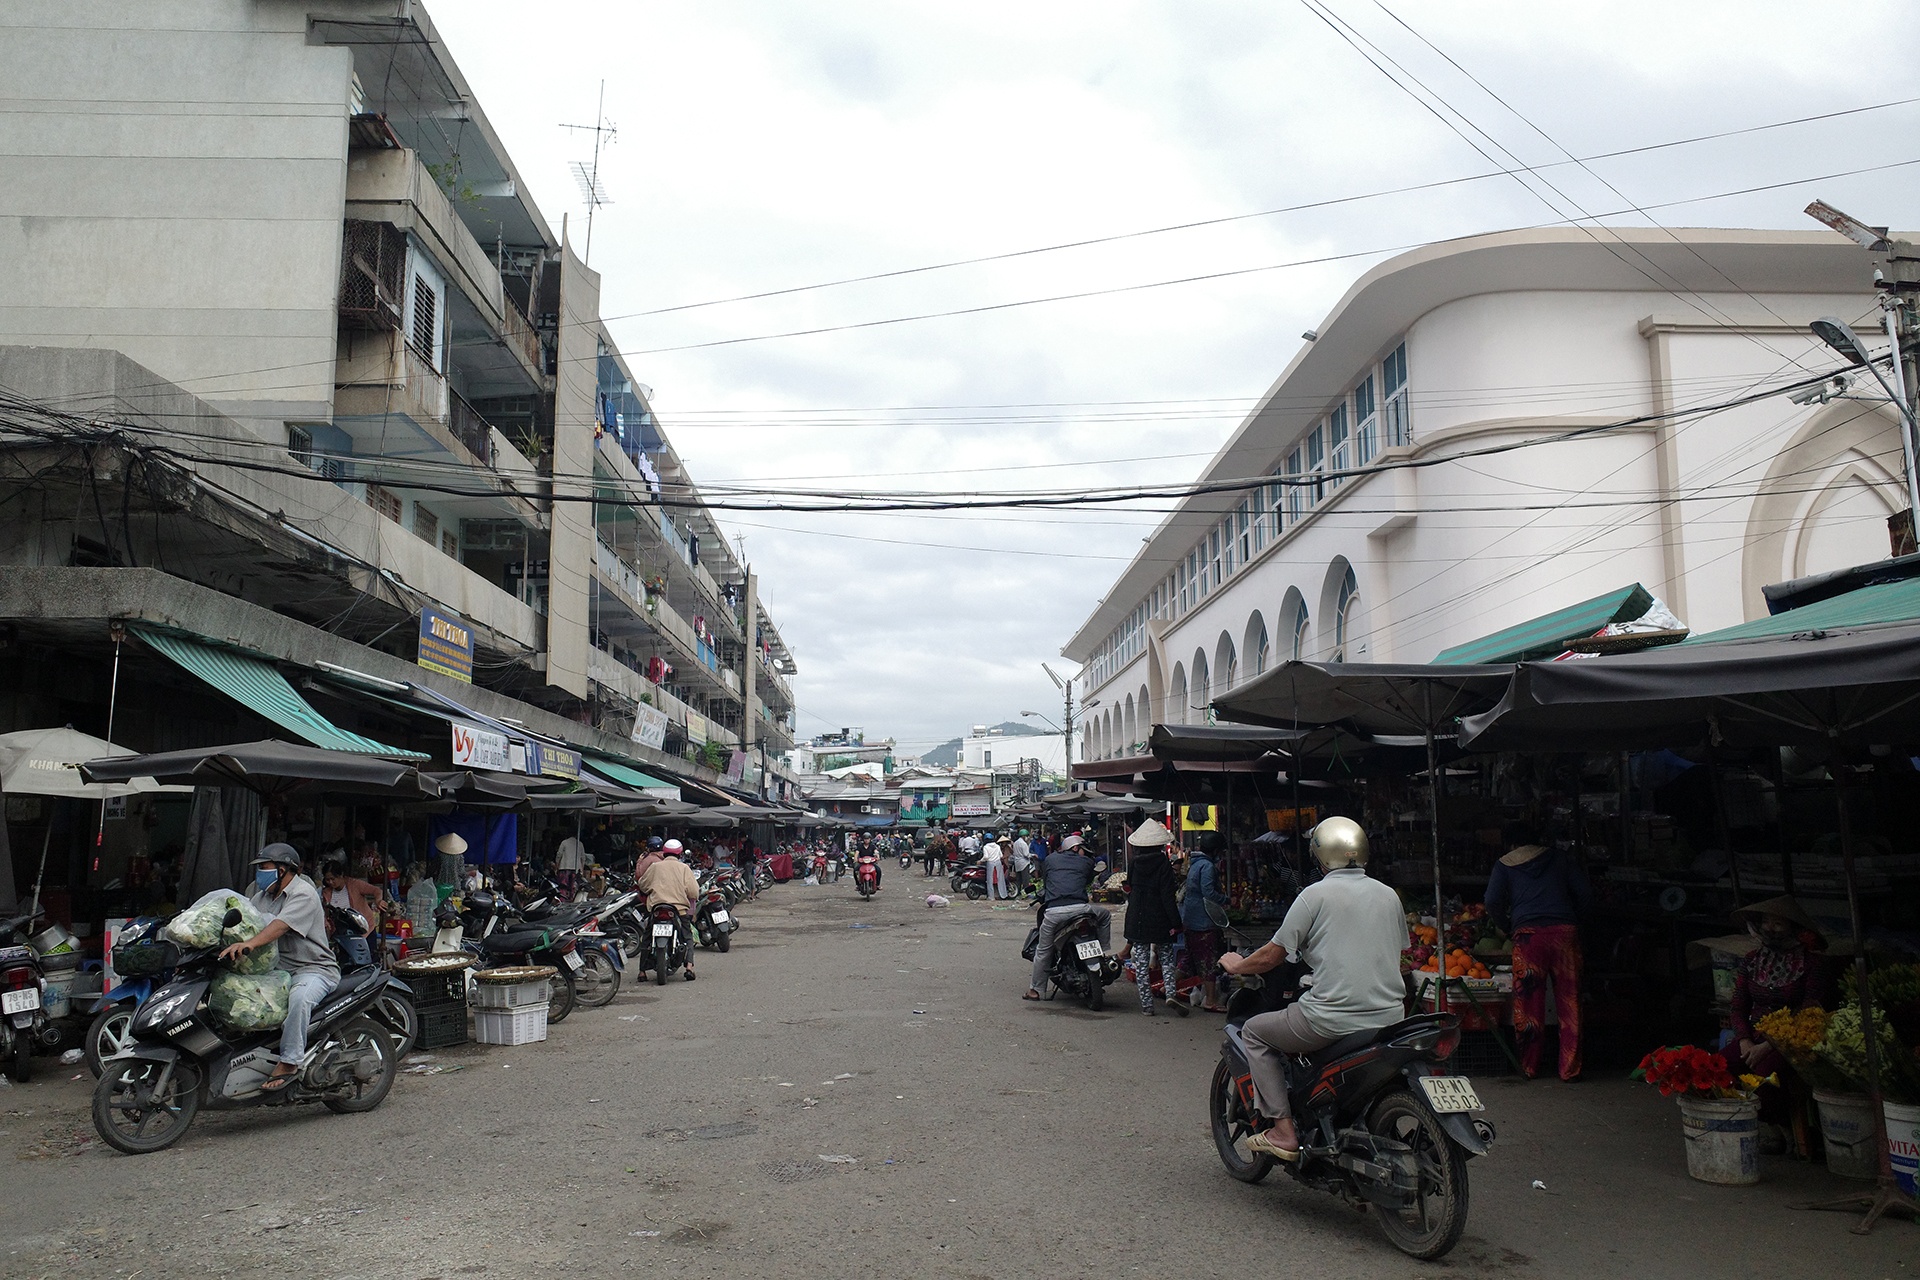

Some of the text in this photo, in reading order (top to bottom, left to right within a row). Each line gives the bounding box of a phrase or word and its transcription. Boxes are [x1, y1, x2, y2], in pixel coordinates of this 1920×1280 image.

[453, 725, 475, 763] Vy
[29, 759, 66, 771] KHÁN
[9, 1000, 35, 1013] 1540
[166, 1019, 194, 1037] YAMAHA
[231, 1054, 257, 1068] AMAHA
[1428, 1079, 1467, 1094] 79-N1
[1432, 1094, 1480, 1110] 355.03
